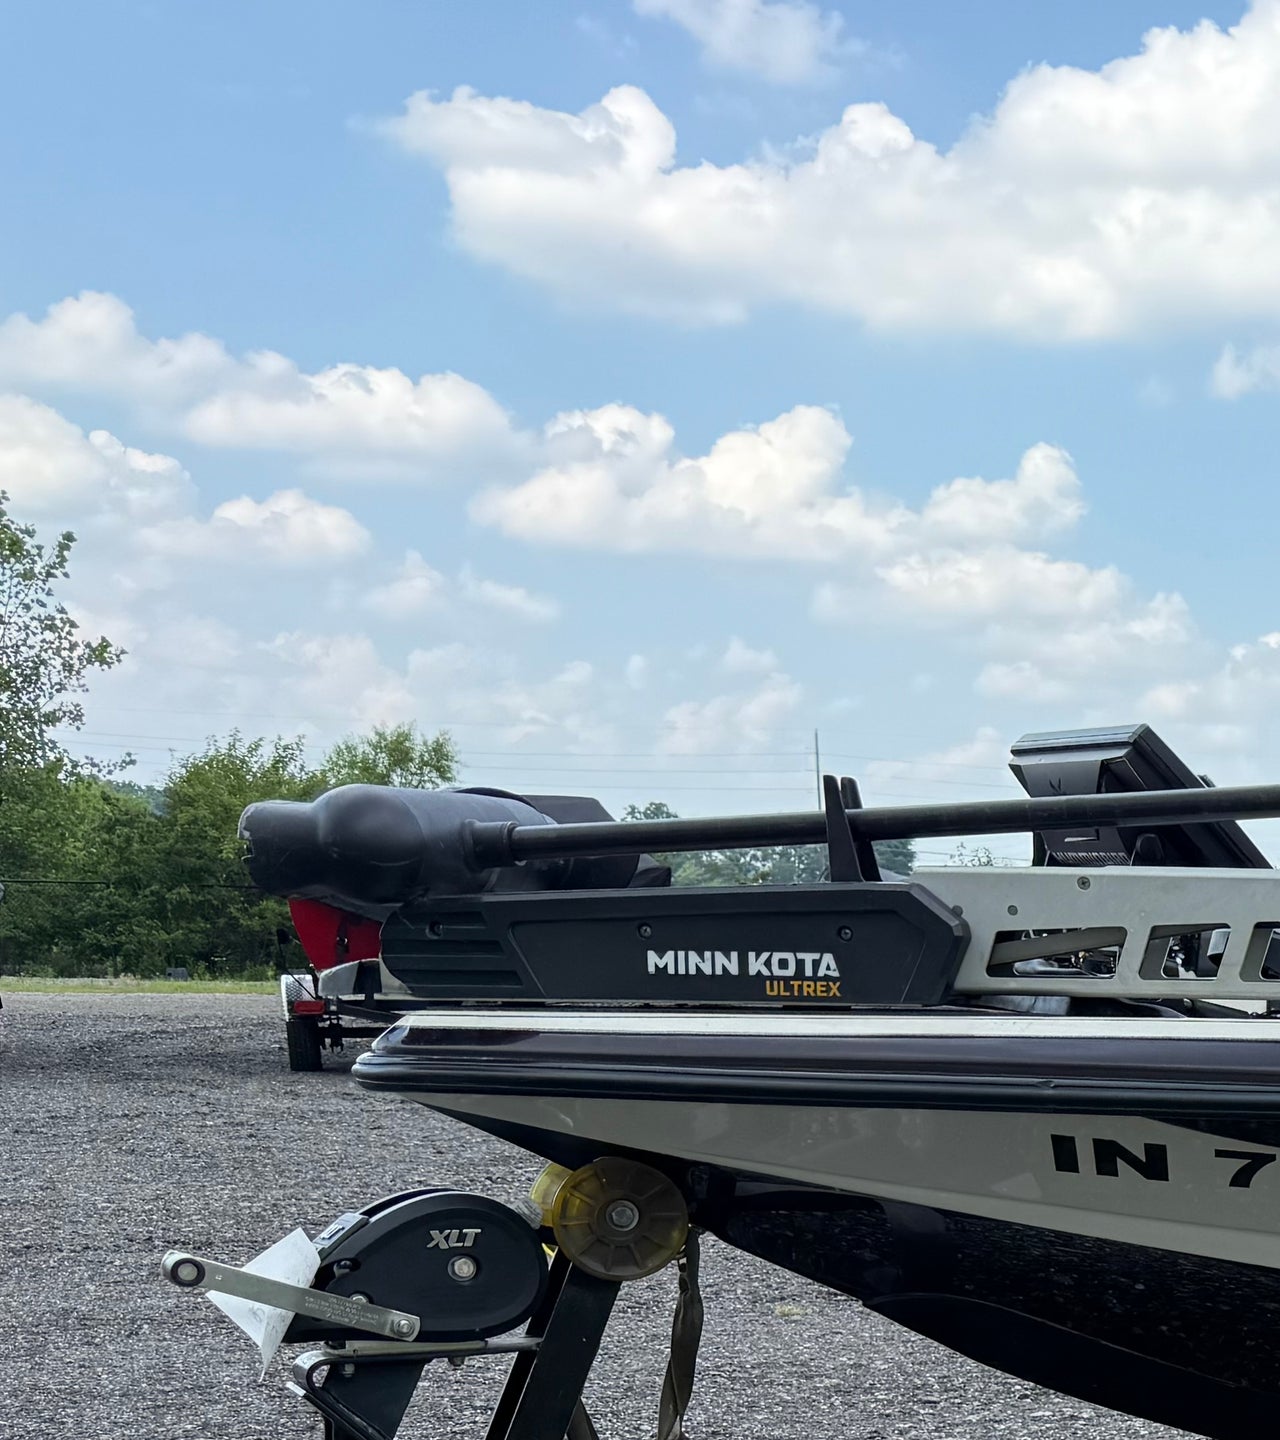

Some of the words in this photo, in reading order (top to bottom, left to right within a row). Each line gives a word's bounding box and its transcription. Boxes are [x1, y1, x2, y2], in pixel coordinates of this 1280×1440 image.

[647, 950, 739, 975] MINN
[748, 951, 840, 977] KOTA
[765, 980, 842, 997] ULTREX
[1050, 1134, 1170, 1182] IN
[426, 1229, 481, 1249] XLT
